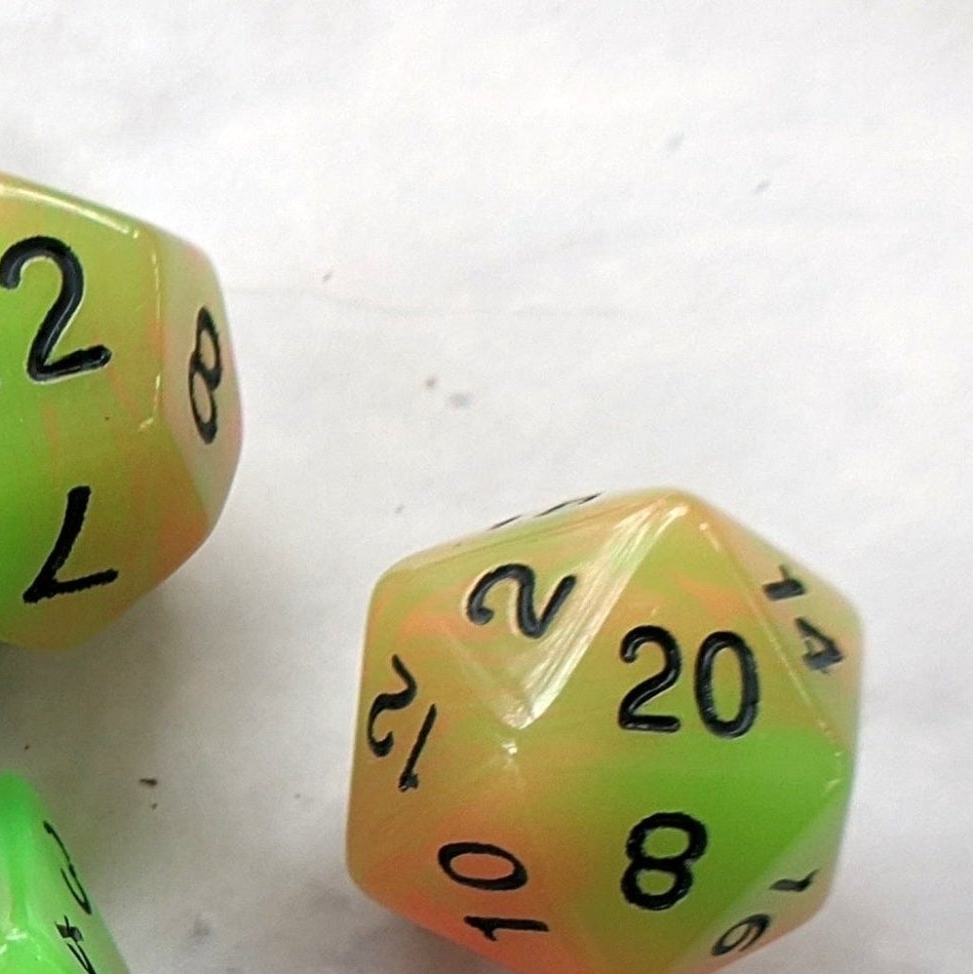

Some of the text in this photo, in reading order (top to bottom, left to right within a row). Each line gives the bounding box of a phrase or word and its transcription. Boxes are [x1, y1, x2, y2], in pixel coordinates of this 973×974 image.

[188, 306, 223, 445] 8
[21, 485, 121, 610] 7
[466, 563, 577, 639] 2
[762, 564, 843, 674] 14
[367, 654, 437, 793] 12
[617, 625, 760, 739] 20
[437, 841, 550, 942] 10
[619, 811, 709, 912] 8
